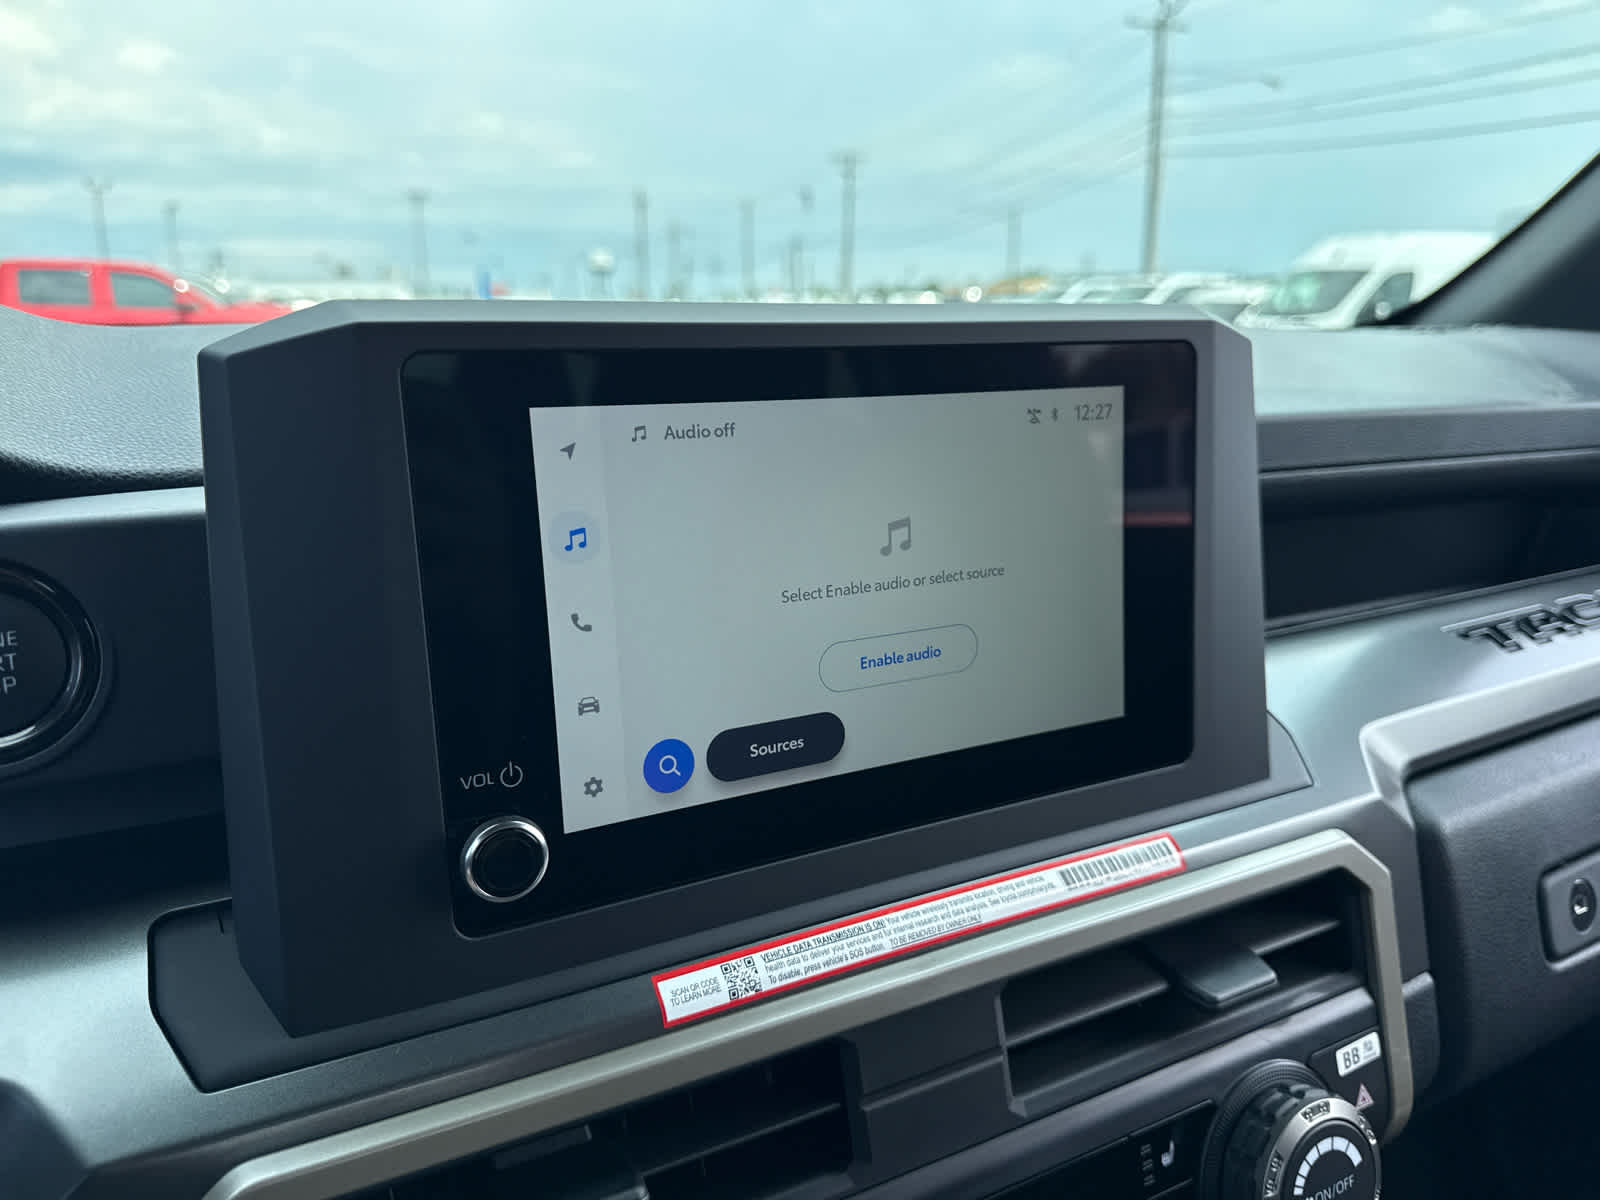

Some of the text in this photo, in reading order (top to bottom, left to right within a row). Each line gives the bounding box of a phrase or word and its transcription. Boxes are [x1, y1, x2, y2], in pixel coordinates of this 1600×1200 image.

[1074, 403, 1113, 421] 12:27
[664, 422, 736, 440] Audio off
[781, 567, 1005, 603] Select Enable audio or select source
[860, 646, 941, 670] Enable audio
[749, 739, 805, 757] Sources
[460, 772, 494, 790] VOL
[760, 946, 791, 961] VEHICLE
[792, 940, 812, 951] DATA
[812, 924, 865, 946] TRANSMISSION
[864, 922, 872, 930] IS
[764, 960, 786, 972] health
[786, 955, 800, 965] data
[808, 947, 830, 959] deliver
[830, 943, 846, 954] your
[845, 935, 870, 947] services
[870, 930, 884, 940] and
[882, 928, 892, 936] for
[914, 914, 940, 927] research
[768, 974, 777, 984] To
[777, 967, 803, 981] disable,
[802, 962, 822, 974] press
[821, 953, 849, 967] vehicle's
[848, 948, 865, 959] SOS
[897, 934, 907, 943] BE
[907, 926, 935, 940] REMOVED
[944, 917, 966, 929] OWNER
[965, 913, 981, 922] ONLY
[670, 985, 689, 997] SCAN
[700, 976, 718, 988] CODE
[680, 991, 701, 1002] LEARN
[702, 984, 721, 996] MORE
[1314, 1174, 1355, 1200] ON/OFF
